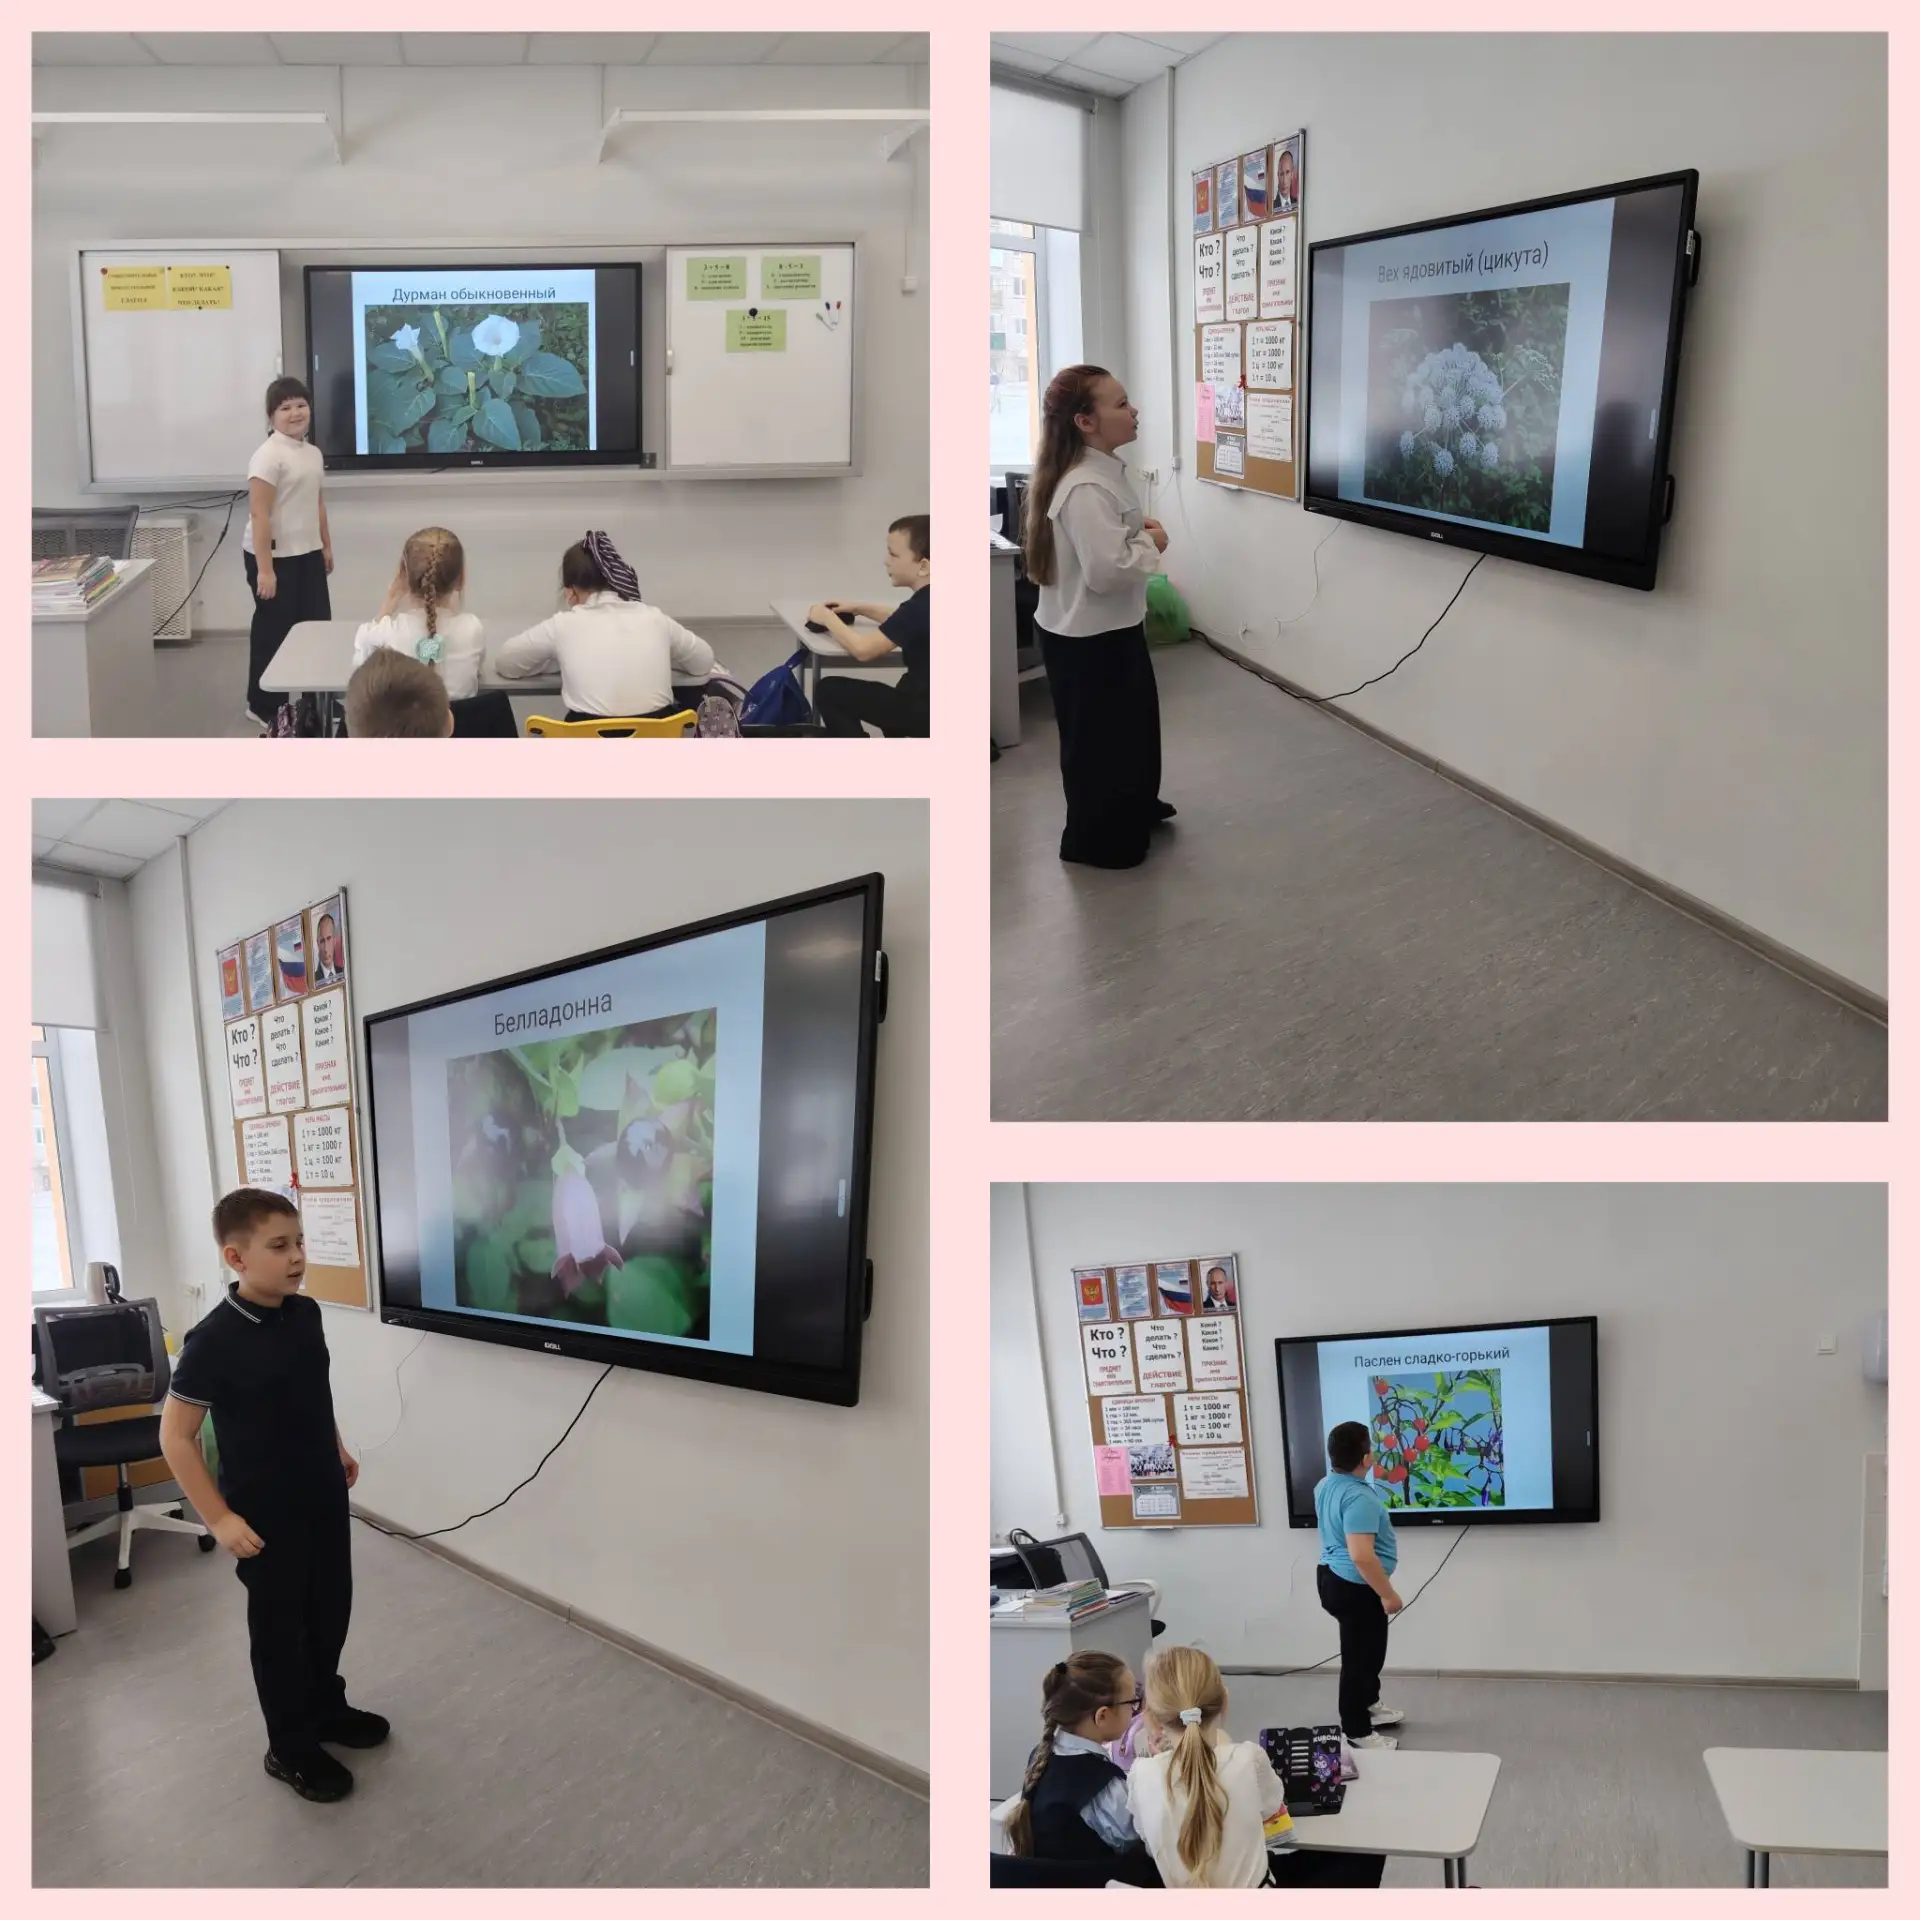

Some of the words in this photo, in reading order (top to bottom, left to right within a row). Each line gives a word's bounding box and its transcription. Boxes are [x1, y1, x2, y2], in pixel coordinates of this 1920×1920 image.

[1200, 244, 1213, 257] Кто
[1216, 240, 1220, 254] ?
[1199, 265, 1213, 278] Что
[1216, 262, 1220, 276] ?
[1378, 266, 1399, 283] Вех
[1403, 255, 1473, 282] ядовитый
[1478, 241, 1549, 276] (цикута)
[393, 288, 446, 303] Дурман
[451, 287, 556, 300] обыкновенный
[494, 993, 612, 1035] Белладонна
[232, 1028, 248, 1045] Кто
[250, 1023, 255, 1040] ?
[271, 1028, 290, 1040] делать
[233, 1054, 250, 1069] Что
[252, 1049, 258, 1065] ?
[1090, 1329, 1114, 1341] Кто
[1118, 1327, 1124, 1339] ?
[1092, 1347, 1116, 1358] Что
[1120, 1346, 1127, 1358] ?
[1145, 1353, 1176, 1361] сделать
[1354, 1356, 1401, 1368] Паслен
[1405, 1347, 1510, 1365] сладко-горький
[1143, 1371, 1182, 1380] ДЕЙСТВИЕ
